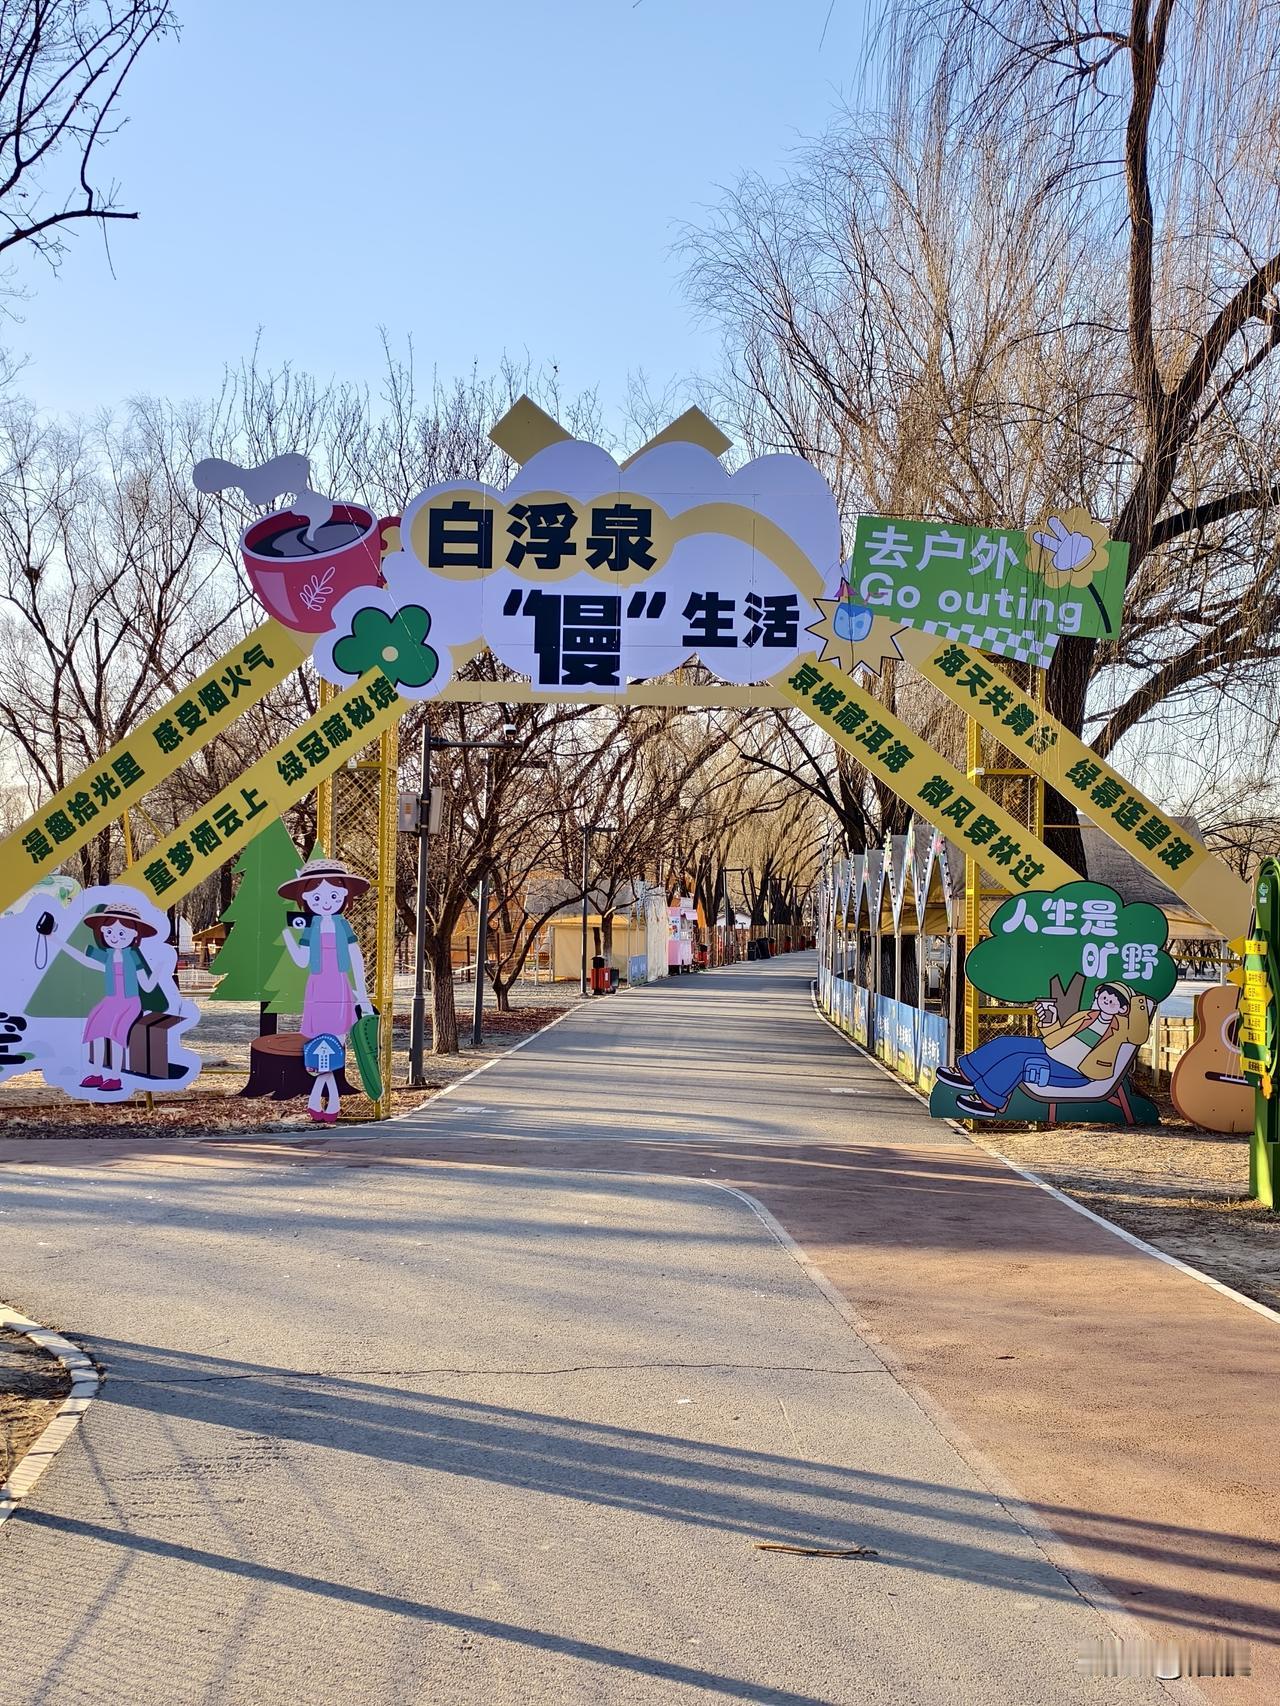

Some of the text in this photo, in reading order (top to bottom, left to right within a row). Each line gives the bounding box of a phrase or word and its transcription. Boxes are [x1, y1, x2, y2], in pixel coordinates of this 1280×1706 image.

[429, 501, 657, 571] 白浮泉
[865, 526, 1019, 579] 去户外
[861, 573, 1083, 633] Go outing
[22, 643, 275, 864] 漫趣拾光里 感受烟火气
[143, 672, 400, 897] 童梦栖云上 绿冠藏秘境
[788, 662, 1045, 889] 京城藏洱海 微风穿林过
[1065, 758, 1194, 870] 绿幕连碧波
[1002, 898, 1119, 938] 人生是
[1081, 941, 1160, 981] 旷野
